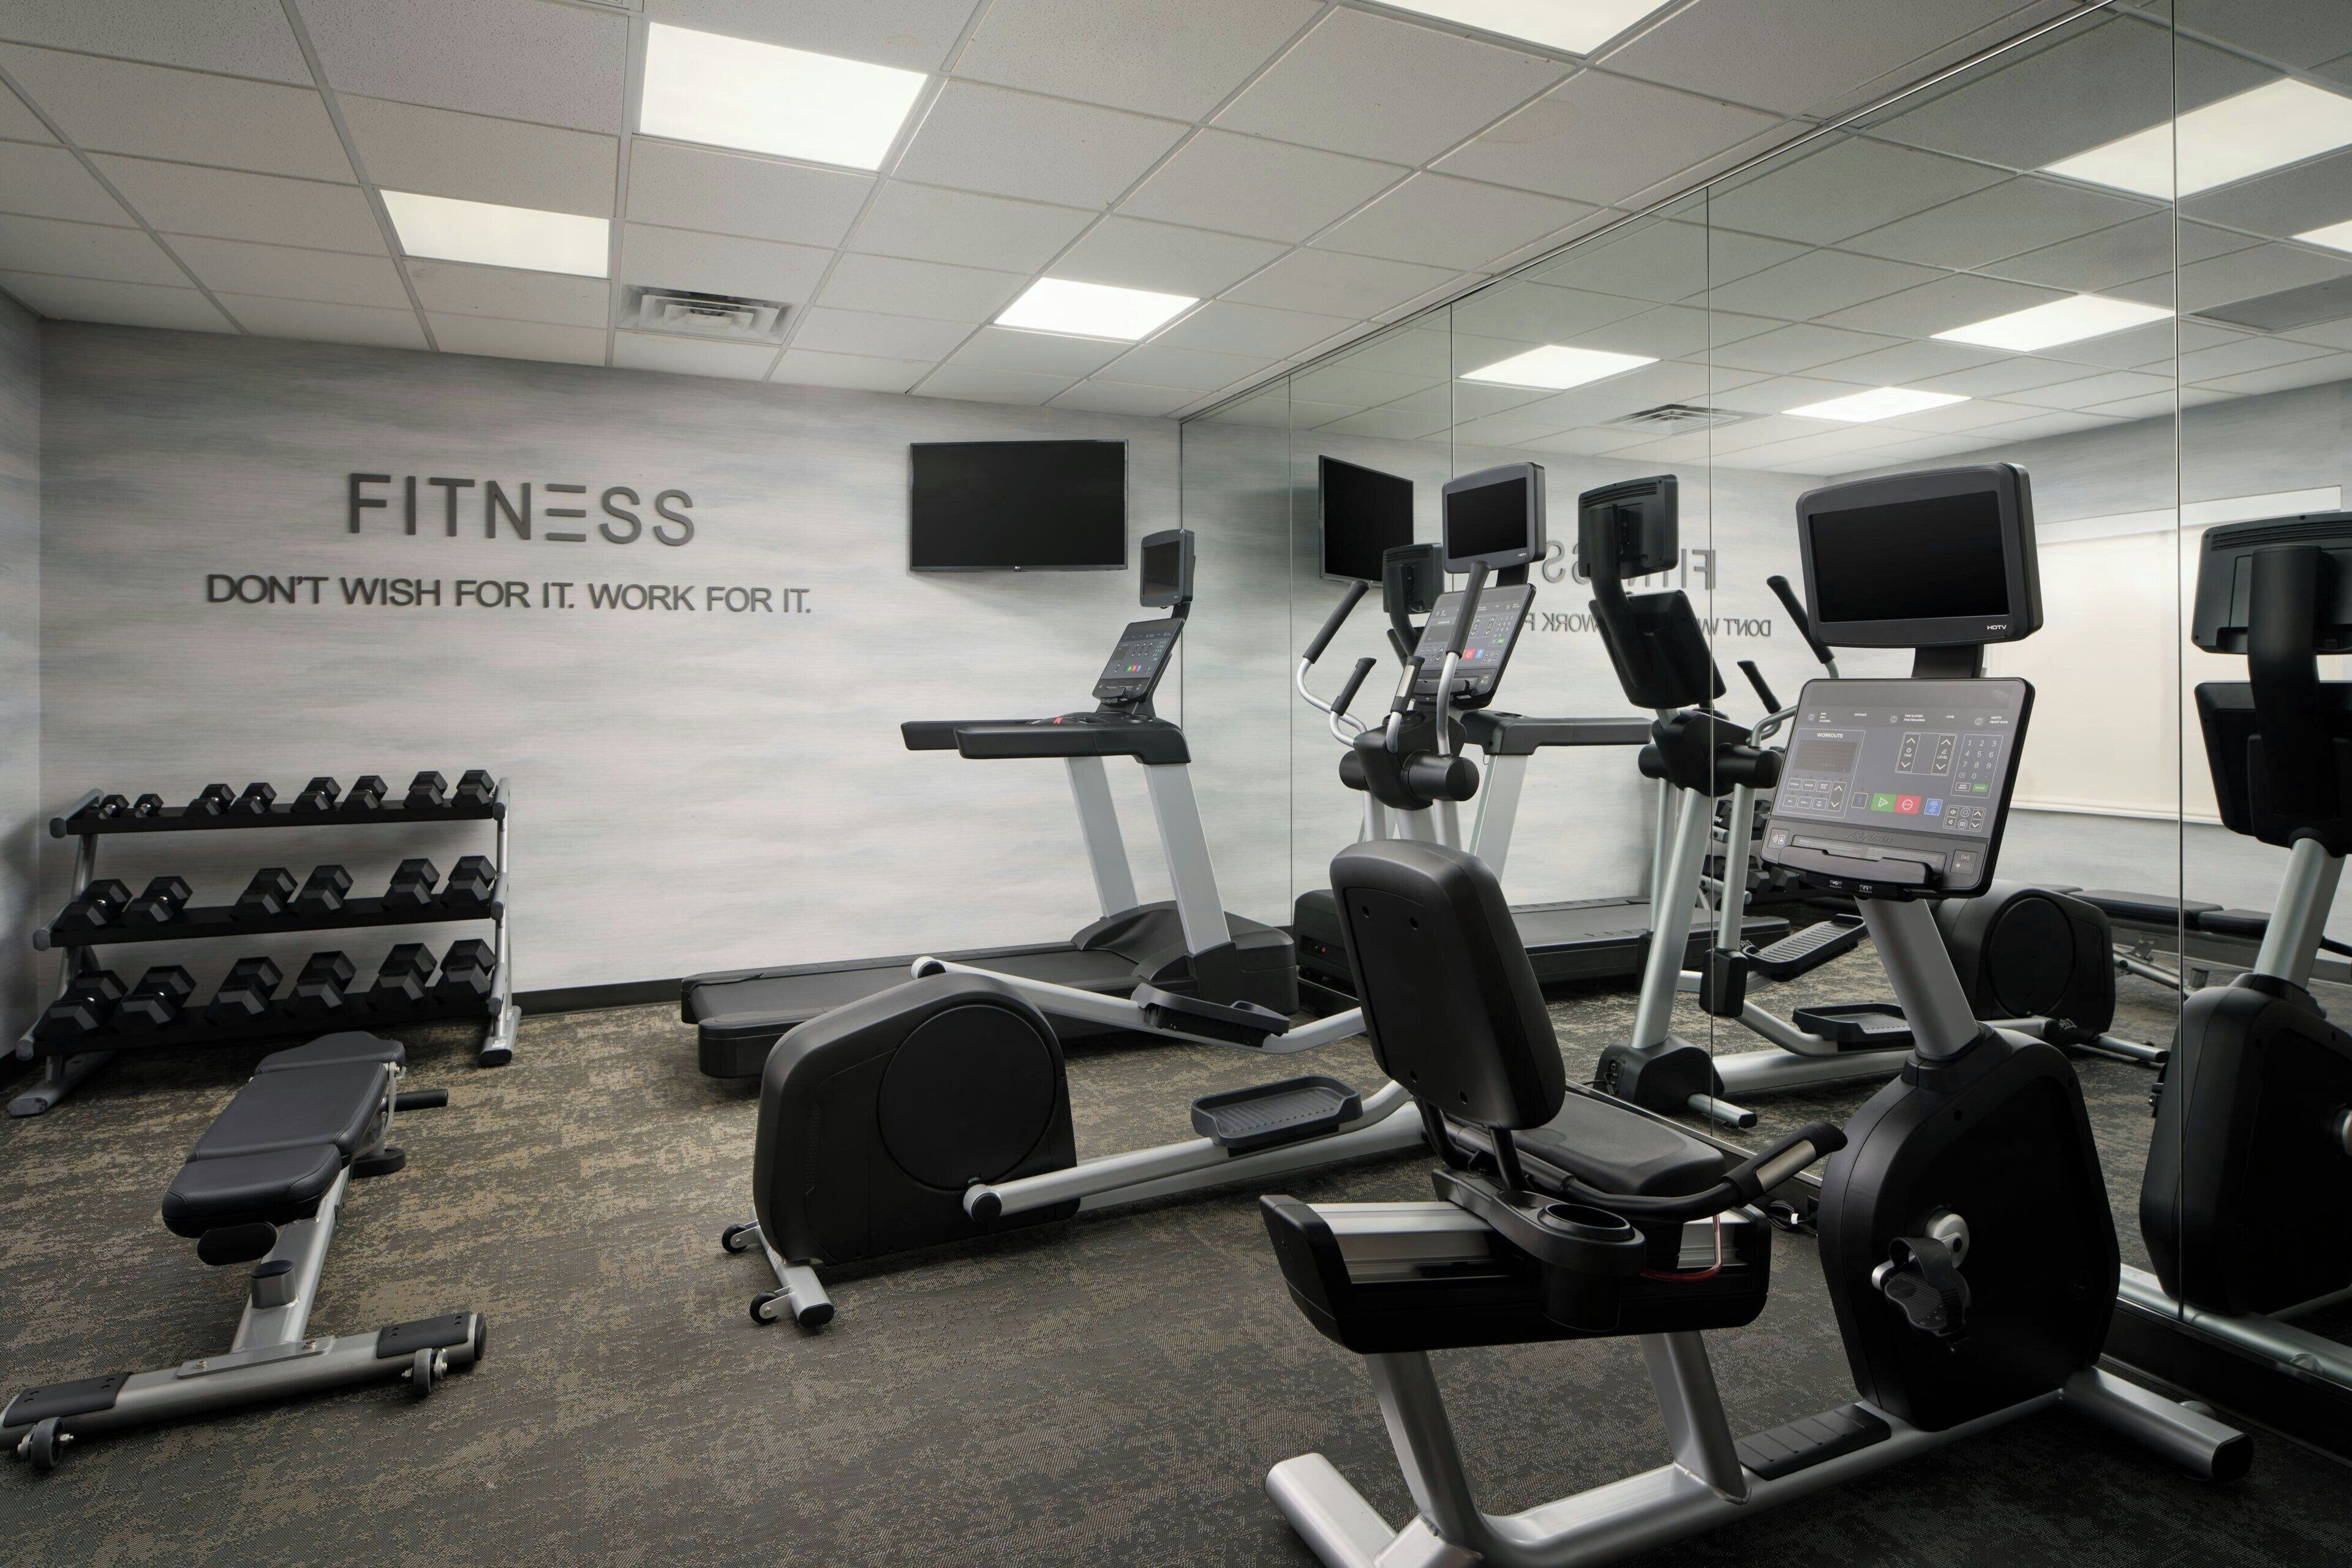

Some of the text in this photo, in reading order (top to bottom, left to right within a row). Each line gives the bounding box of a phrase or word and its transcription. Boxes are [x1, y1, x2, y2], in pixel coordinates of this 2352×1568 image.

[349, 472, 695, 546] FITNESS
[207, 574, 811, 613] DON'T WISH FOR IT. WORK FOR IT.
